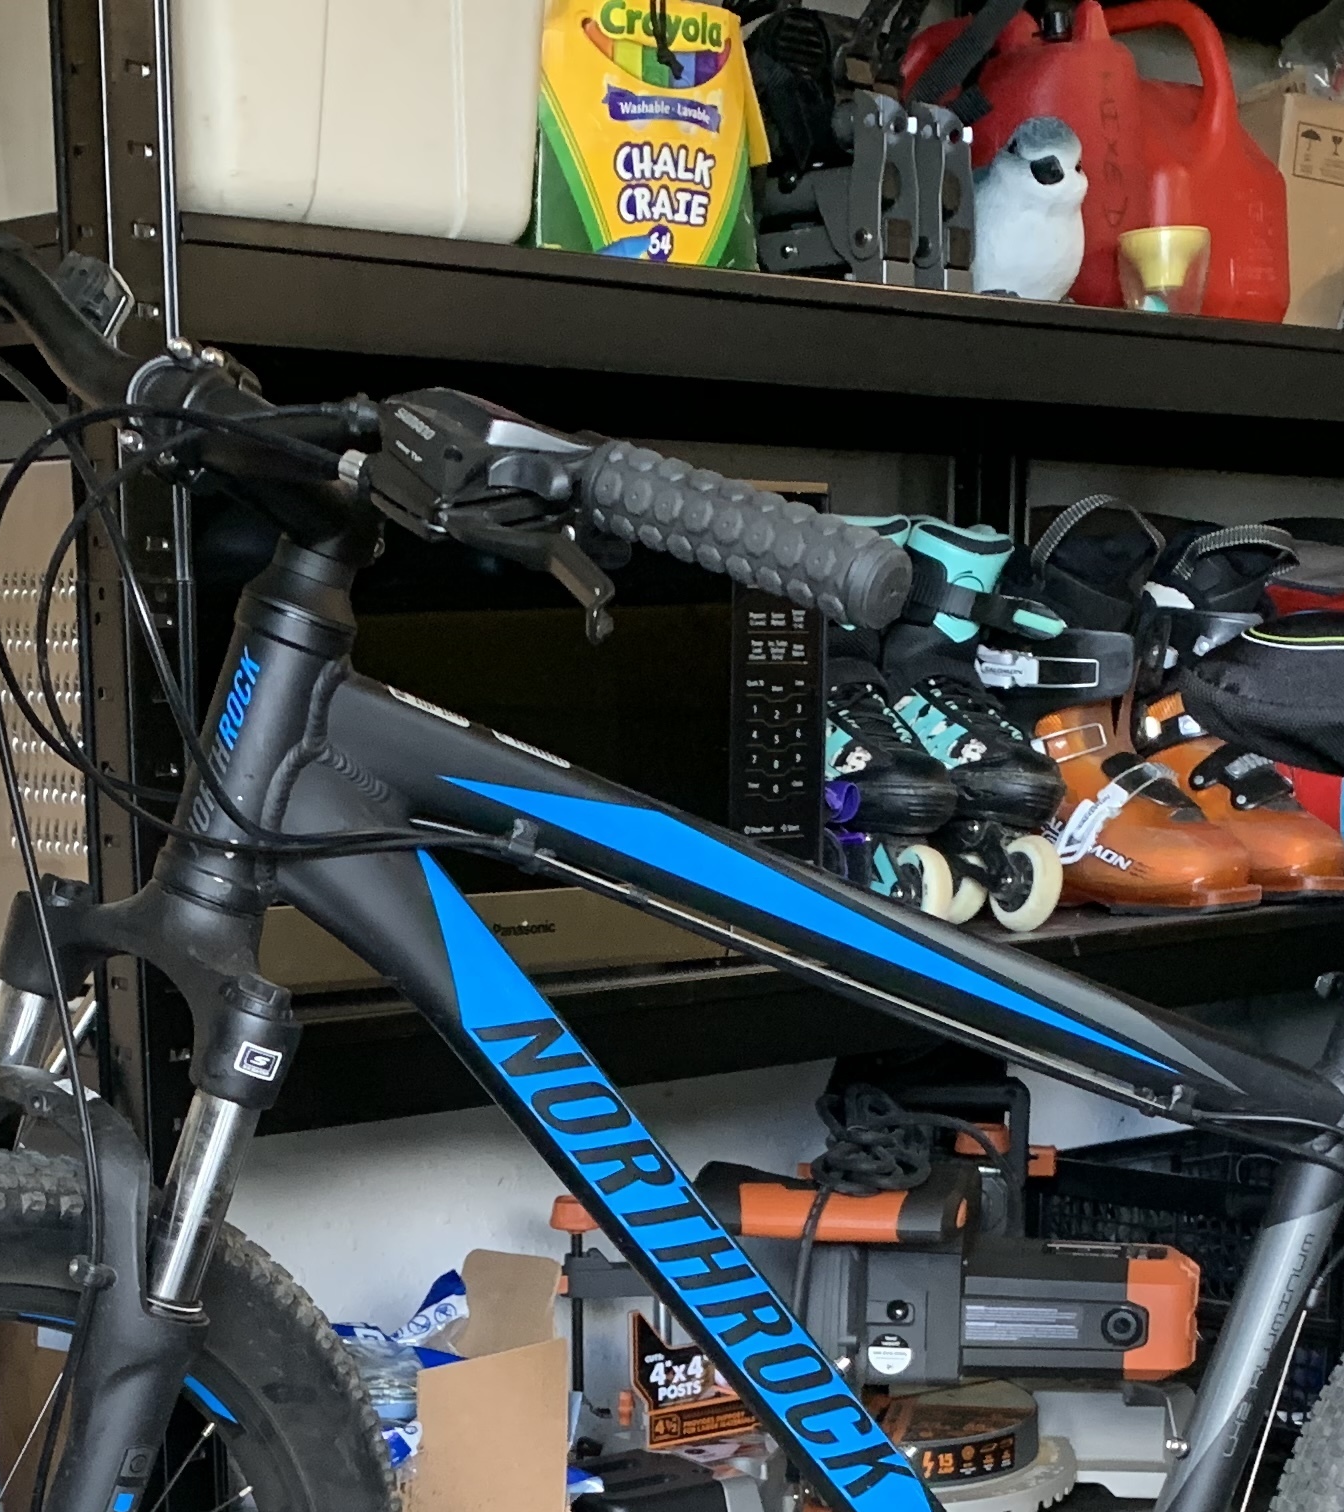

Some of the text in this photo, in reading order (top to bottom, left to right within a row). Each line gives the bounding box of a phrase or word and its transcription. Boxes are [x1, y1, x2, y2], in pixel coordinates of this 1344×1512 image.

[619, 101, 710, 124] Washable Lavable
[615, 142, 716, 188] CHALK
[617, 183, 710, 226] CRAIE
[649, 232, 672, 256] 64
[493, 920, 555, 937] Panasonic
[472, 1017, 918, 1498] NORTHROCK
[657, 1381, 702, 1401] POSTS
[938, 1452, 953, 1466] 15
